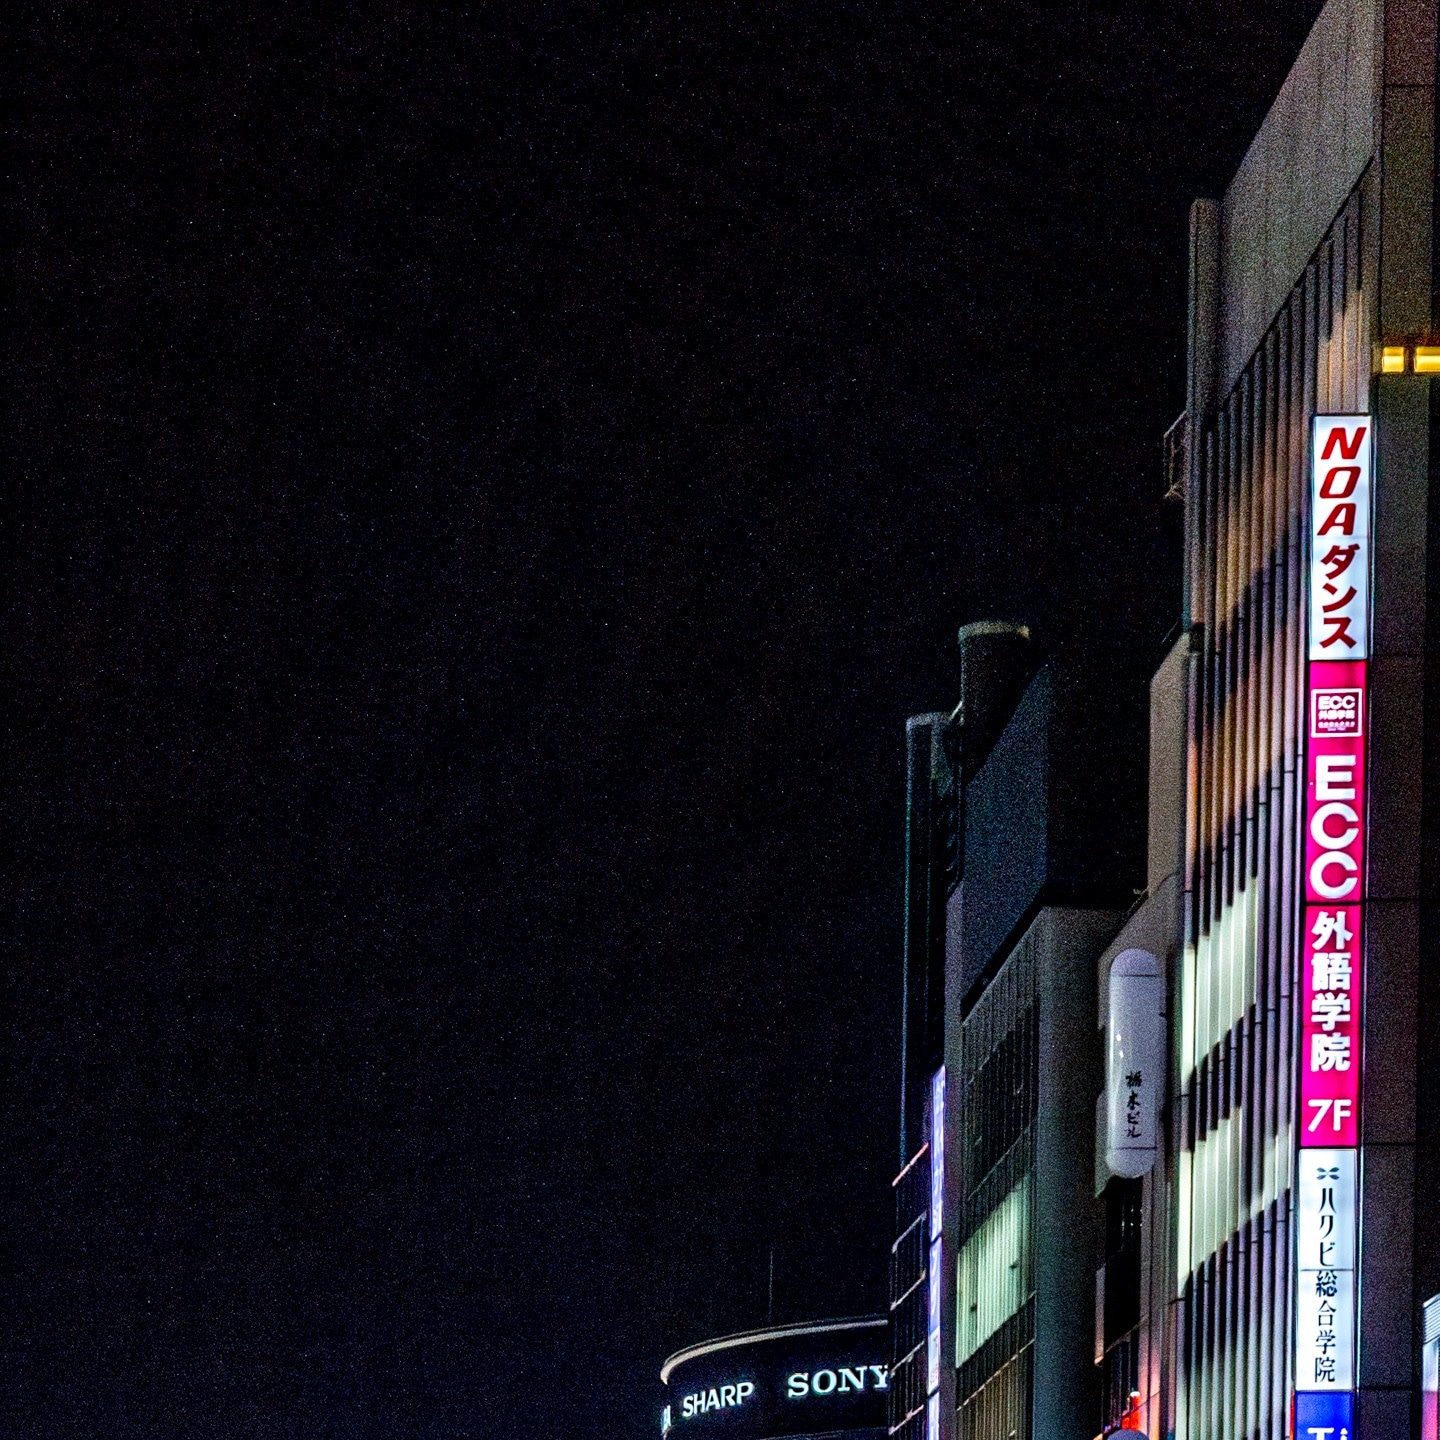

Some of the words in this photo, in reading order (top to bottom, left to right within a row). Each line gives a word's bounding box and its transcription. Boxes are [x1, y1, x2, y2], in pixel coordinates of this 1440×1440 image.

[1317, 426, 1367, 649] NOAダンス
[1318, 695, 1355, 709] ECC
[1310, 755, 1359, 899] ECC
[1311, 911, 1353, 1073] 外語学院
[1307, 1099, 1351, 1133] 7F
[1313, 1187, 1338, 1383] ハクビ総合学院
[682, 1381, 755, 1418] SHARP
[787, 1364, 888, 1398] SONY
